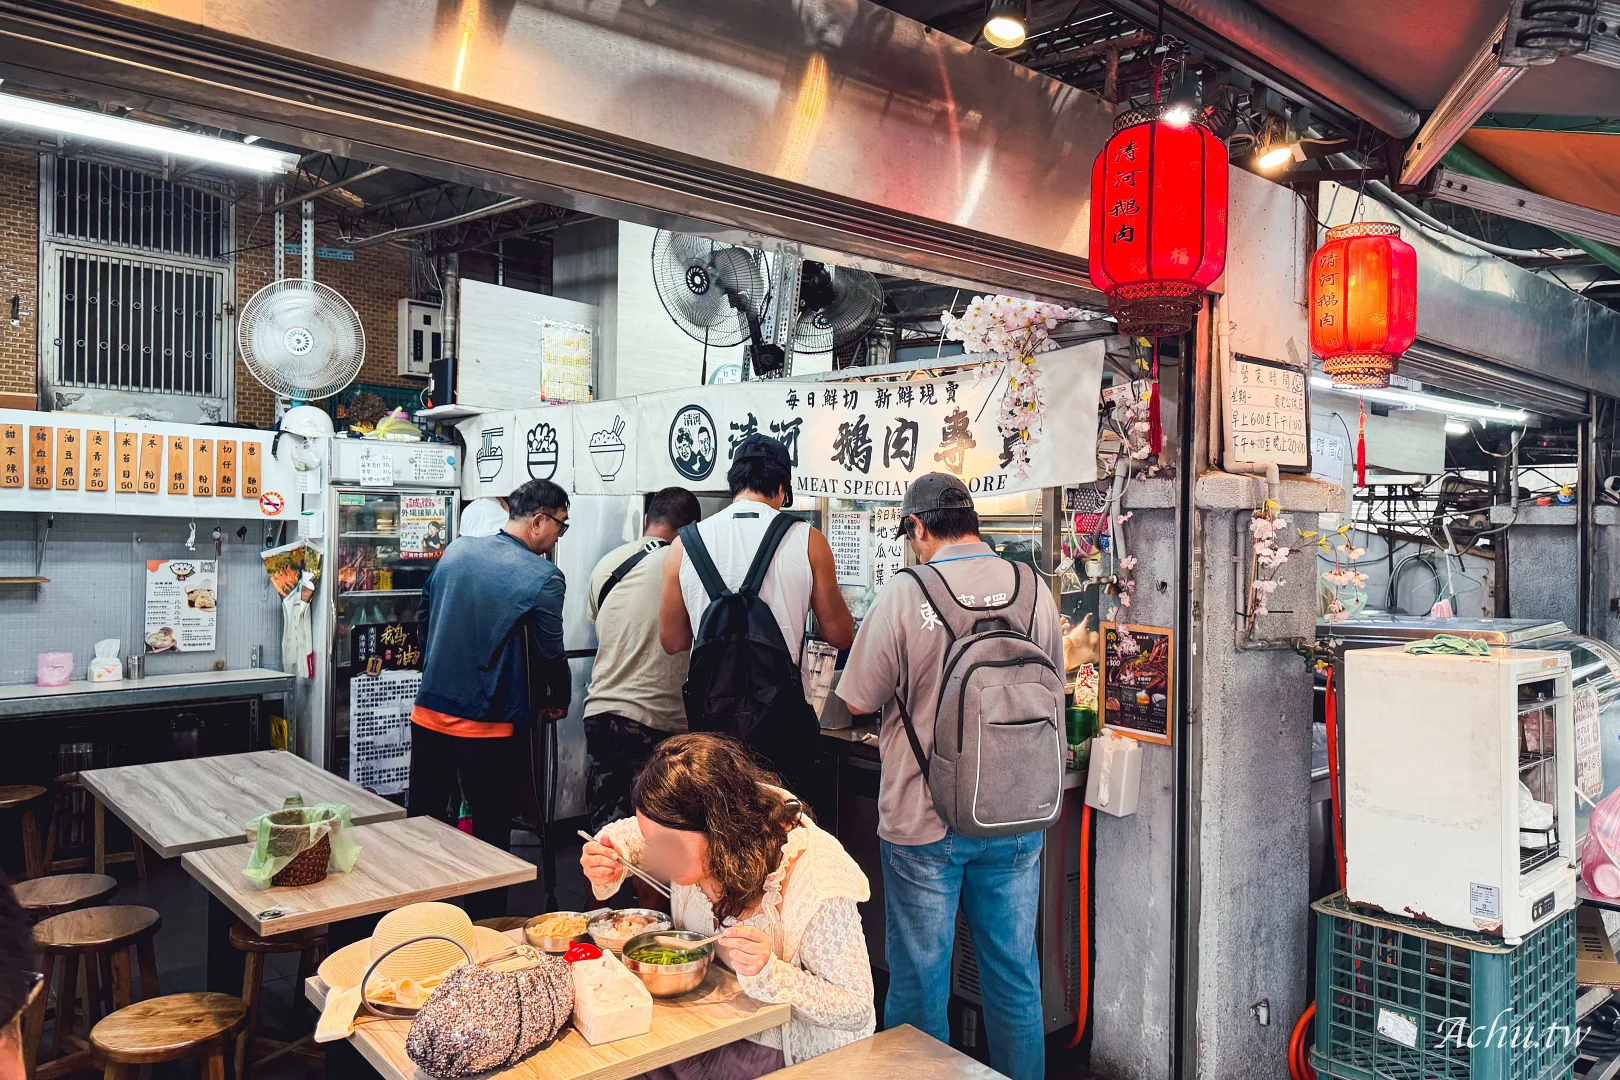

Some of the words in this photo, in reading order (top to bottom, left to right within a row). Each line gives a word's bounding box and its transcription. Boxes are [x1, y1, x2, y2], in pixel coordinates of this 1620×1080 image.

[1110, 141, 1142, 244] 清河鵝肉
[1316, 251, 1339, 327] 清河鵝肉
[785, 388, 859, 410] 每日鮮切
[874, 381, 959, 409] 新鮮現賣
[683, 413, 701, 426] 清河
[5, 430, 17, 474] 甜不辣
[36, 432, 46, 475] 豬血糕
[63, 434, 75, 477] 油豆腐
[93, 435, 102, 478] 燙青菜
[122, 438, 131, 479] 米苔目
[144, 437, 157, 480] 冬粉
[174, 441, 183, 481] 板條
[199, 444, 208, 484] 米粉
[222, 445, 232, 484] 切仔麵
[247, 447, 257, 485] 意麵
[36, 477, 48, 485] 50
[143, 482, 156, 490] 50
[173, 482, 185, 490] 50
[198, 486, 210, 494] 50
[797, 477, 838, 493] MEAT
[963, 474, 1008, 493] ORE
[875, 526, 888, 585] 地瓜葉
